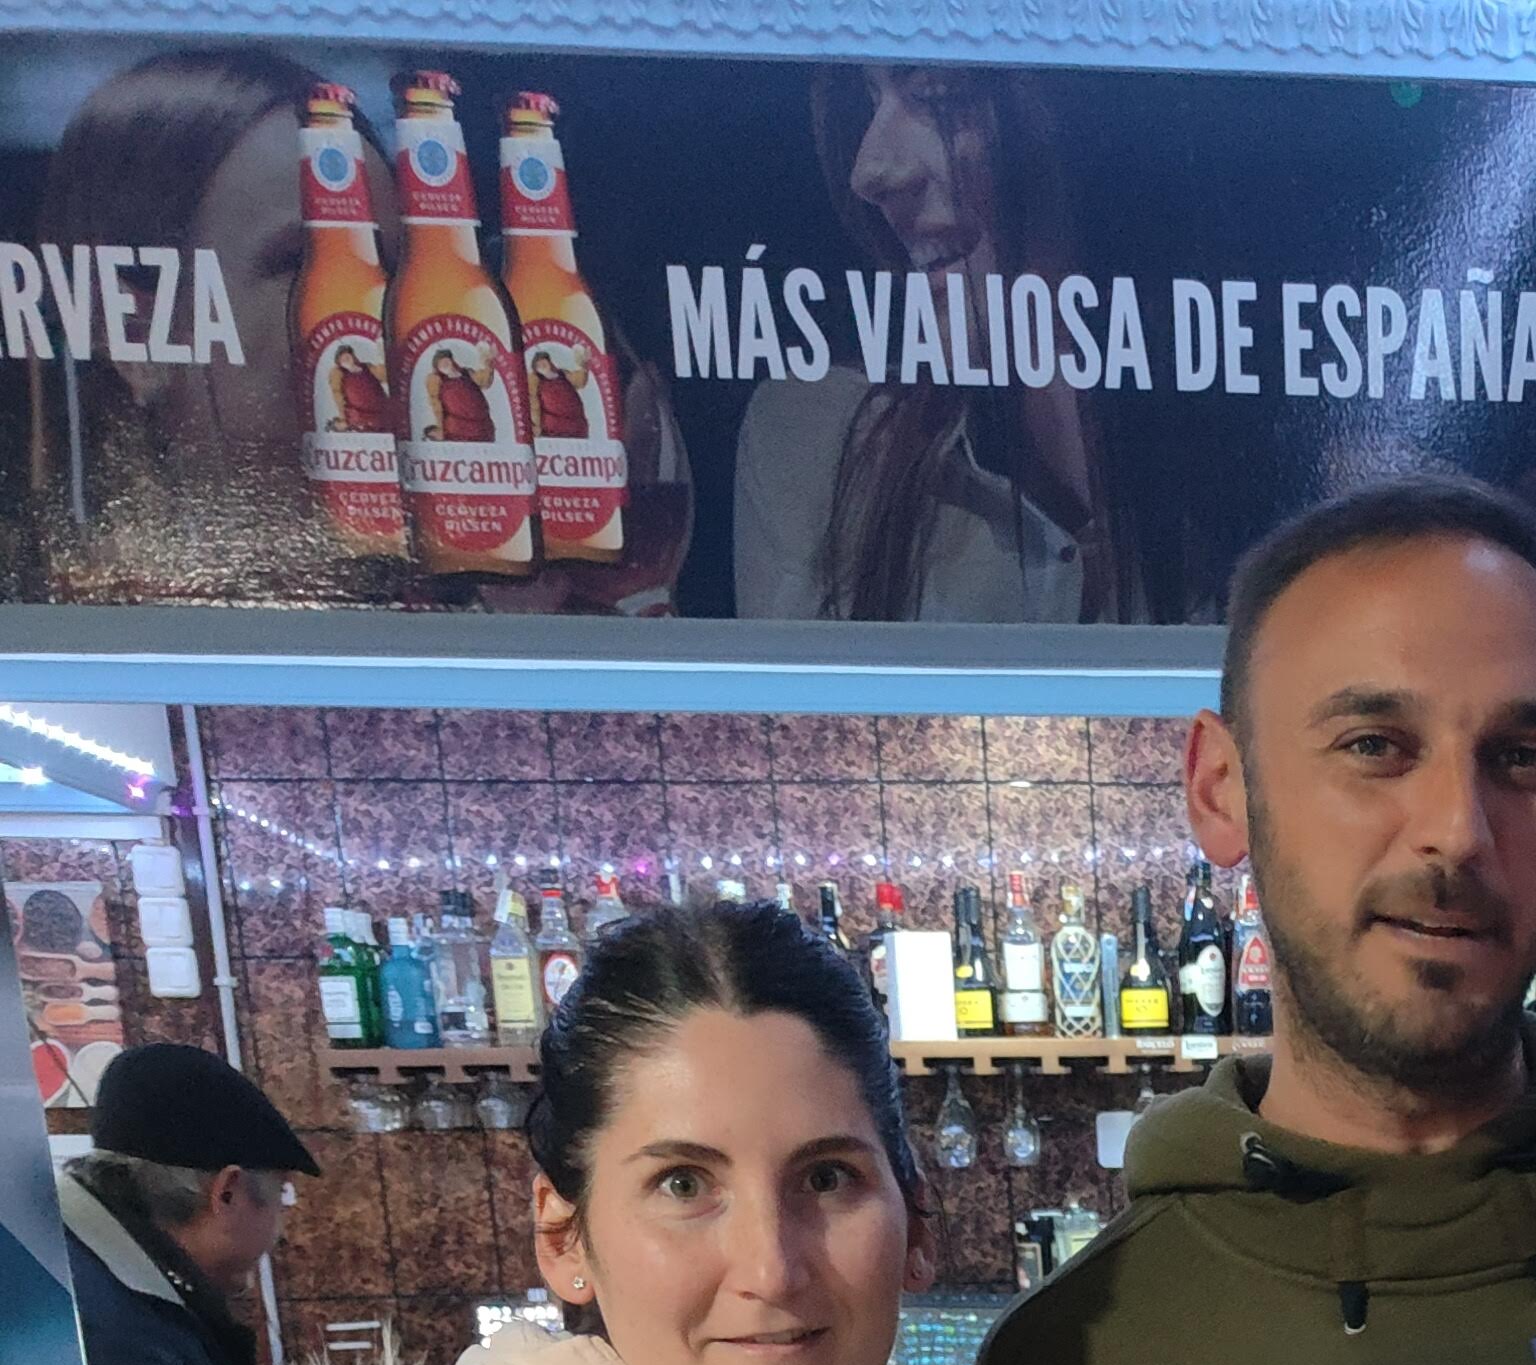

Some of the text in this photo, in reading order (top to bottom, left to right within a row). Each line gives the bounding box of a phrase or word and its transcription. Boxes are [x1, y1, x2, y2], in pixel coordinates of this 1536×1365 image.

[0, 242, 245, 366] RVEZA
[665, 244, 831, 382] MÁS
[845, 268, 1153, 391] VALIOSA
[1173, 278, 1262, 395] DE
